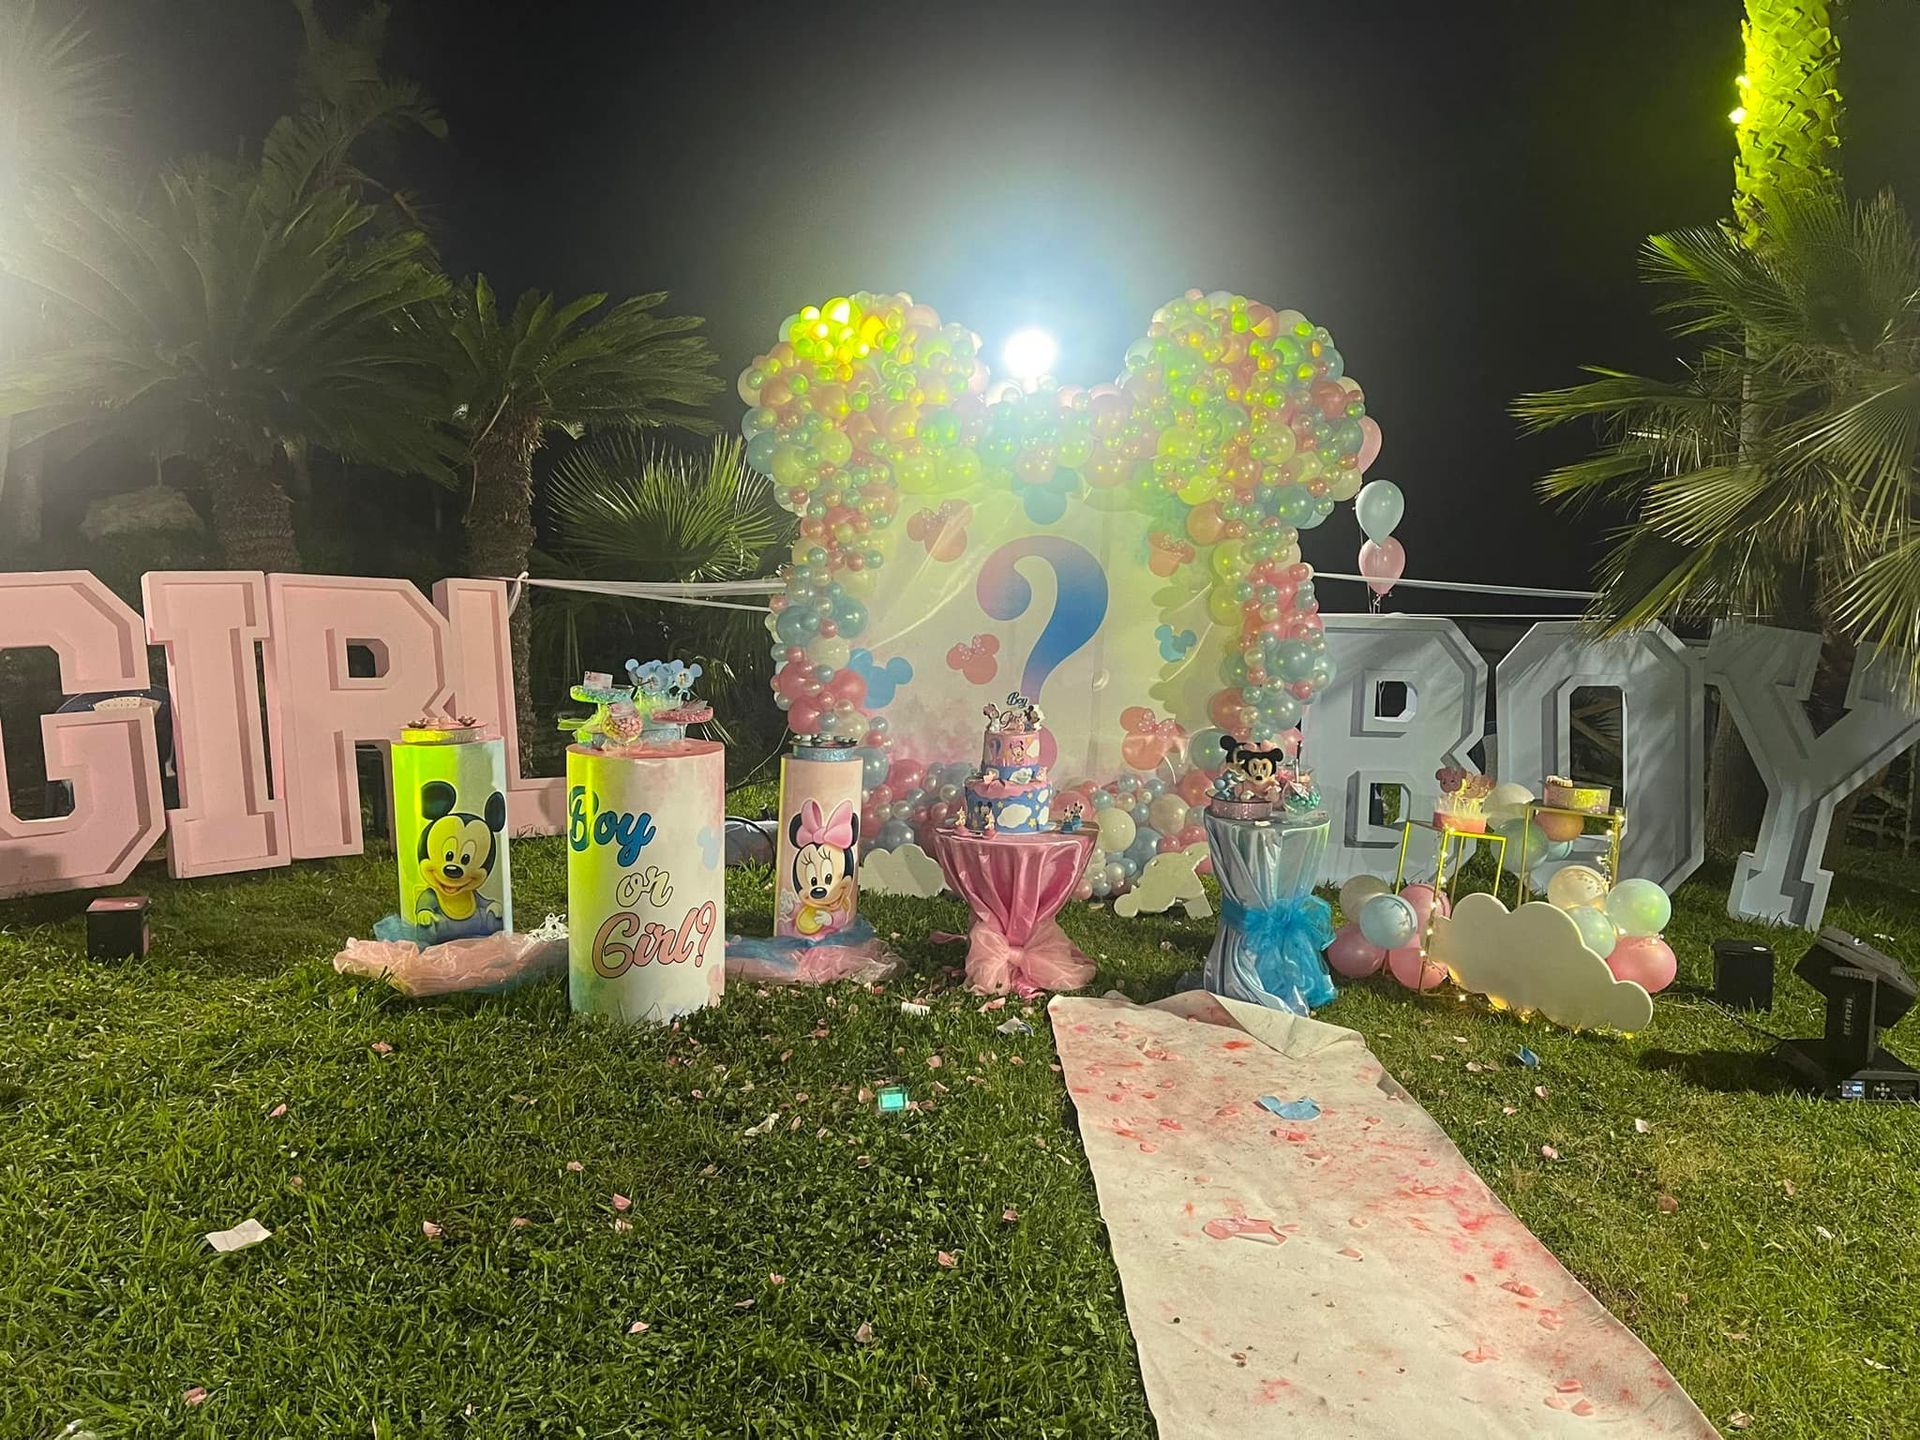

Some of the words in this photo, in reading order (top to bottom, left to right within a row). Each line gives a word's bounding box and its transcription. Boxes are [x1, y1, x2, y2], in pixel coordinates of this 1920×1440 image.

[0, 570, 566, 899] GIRL
[1303, 613, 1920, 932] BOY
[568, 785, 656, 868] Boy
[616, 866, 673, 907] or
[592, 901, 716, 979] Girl?
